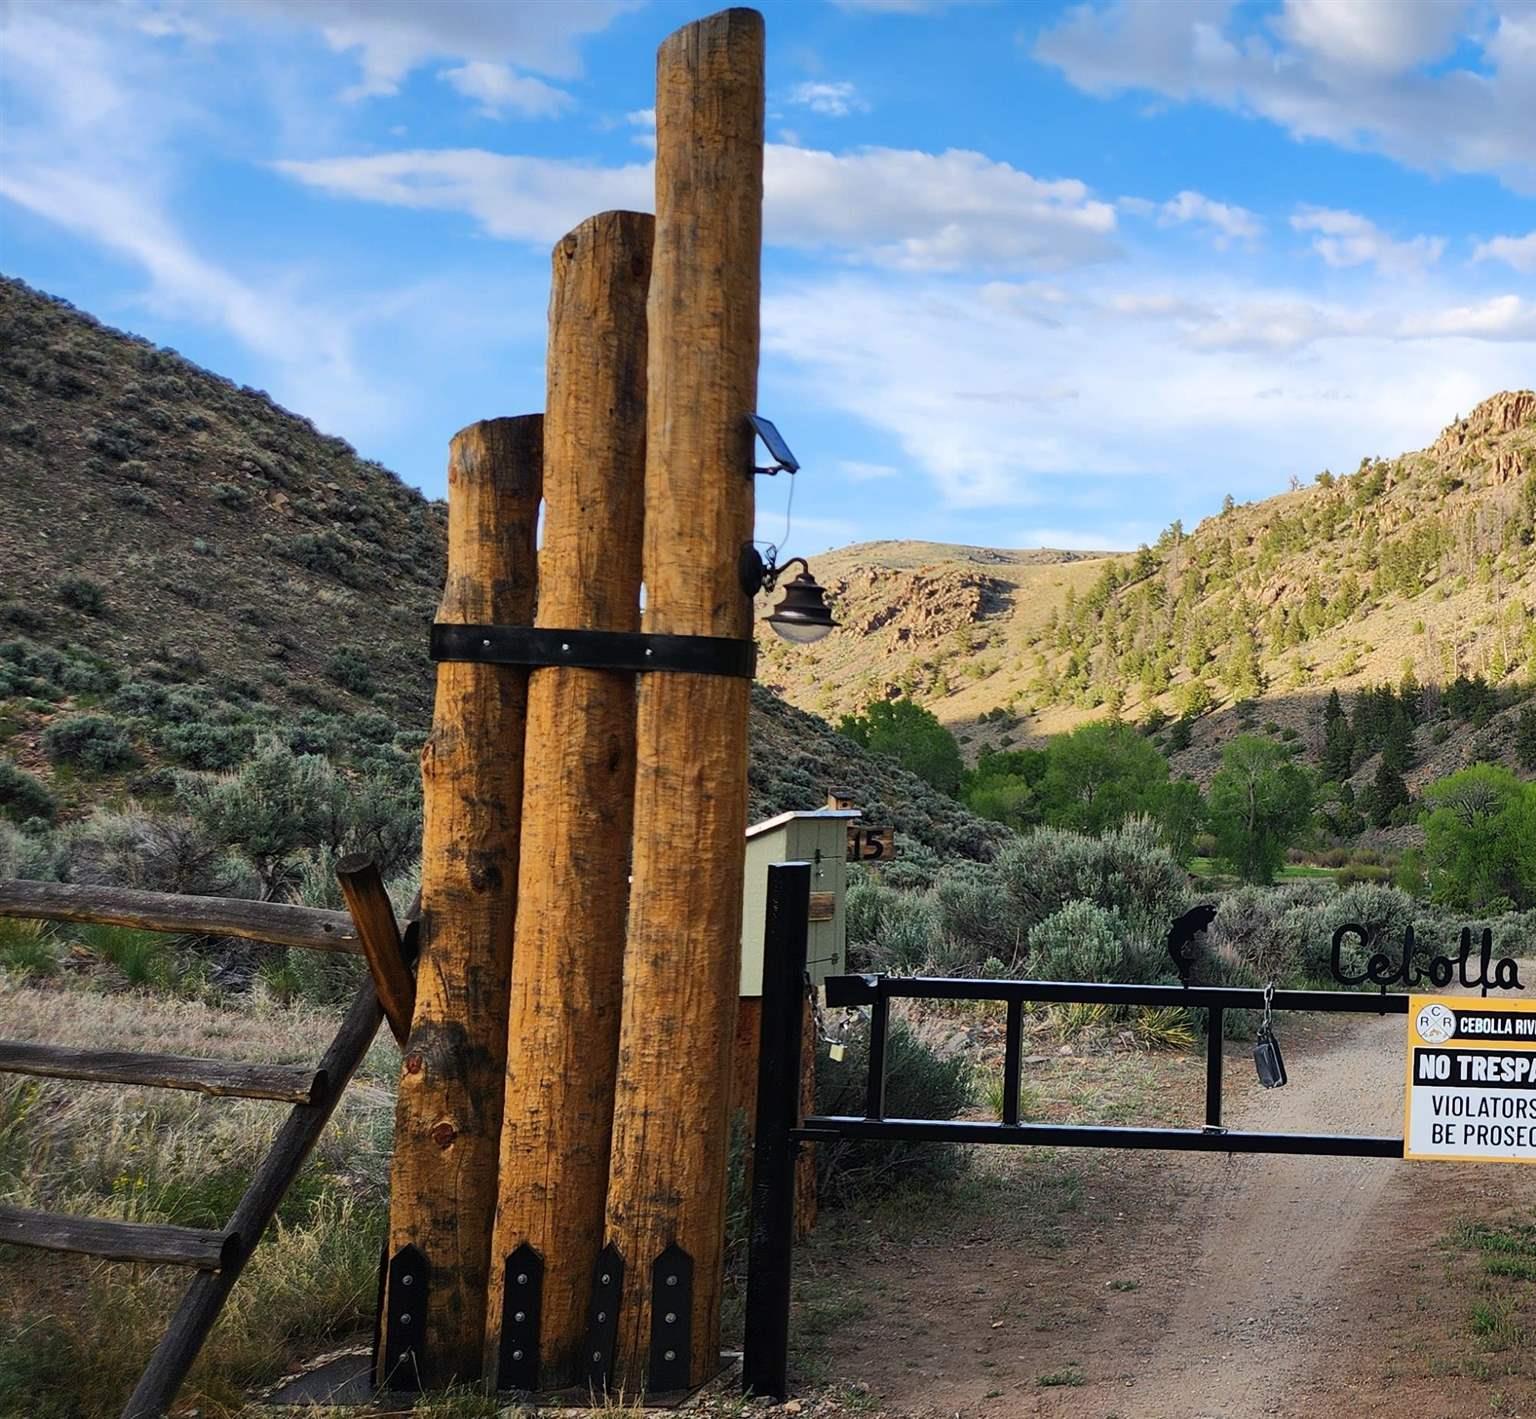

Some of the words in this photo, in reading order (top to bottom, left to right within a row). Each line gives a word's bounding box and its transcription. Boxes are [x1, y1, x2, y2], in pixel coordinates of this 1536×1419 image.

[1331, 923, 1526, 992] Cebolla
[1460, 1017, 1512, 1035] CEBOLLA
[1419, 1054, 1451, 1080] NO
[1431, 1123, 1456, 1145] BE
